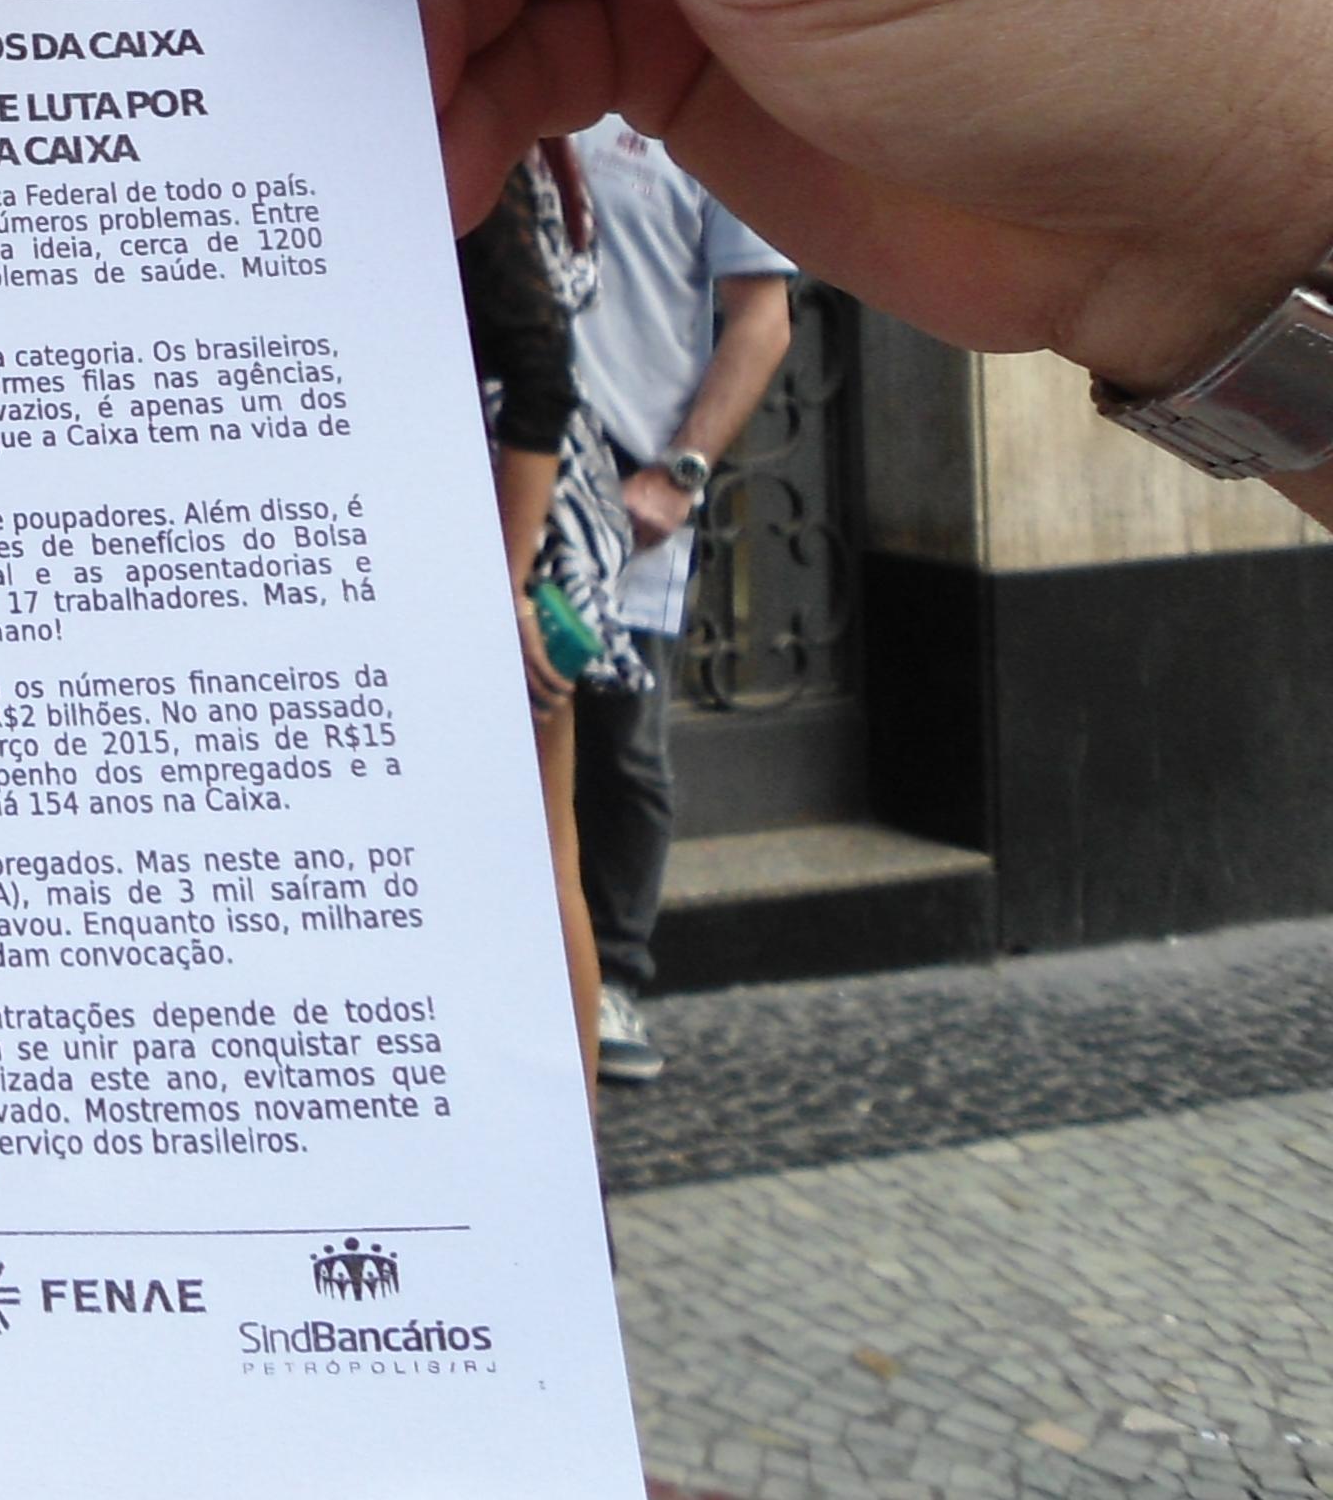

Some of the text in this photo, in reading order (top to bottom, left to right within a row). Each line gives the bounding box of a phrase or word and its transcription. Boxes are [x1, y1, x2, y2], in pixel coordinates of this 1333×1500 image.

[31, 32, 87, 61] DA
[88, 28, 206, 60] CAIXA
[25, 90, 125, 122] LUTA
[126, 87, 211, 119] POR
[23, 132, 142, 167] CAIXA
[25, 180, 118, 207] Federal
[125, 179, 158, 204] de
[163, 177, 223, 202] todo
[231, 181, 247, 199] o
[255, 172, 316, 204] país.
[98, 205, 241, 237] problemas.
[250, 201, 320, 226] Entre
[80, 367, 136, 393] filas
[153, 369, 200, 391] nas
[216, 359, 342, 392] agências,
[35, 566, 52, 586] e
[73, 565, 104, 585] as
[125, 552, 333, 589] aposentadorias
[355, 555, 372, 574] e
[94, 759, 144, 785] dos
[159, 753, 333, 789] empregados
[349, 758, 368, 778] e
[384, 756, 402, 777] a
[28, 790, 80, 817] 154
[88, 794, 154, 816] anos
[162, 792, 197, 814] na
[204, 784, 291, 812] Caixa.
[59, 937, 234, 972] convocação.
[89, 1065, 151, 1092] este
[166, 1069, 228, 1094] ano,
[243, 1061, 376, 1090] evitamos
[391, 1064, 447, 1093] que
[84, 1096, 241, 1124] Mostremos
[253, 1092, 420, 1122] novamente
[433, 1095, 451, 1118] a
[39, 1278, 208, 1314] FENAE
[237, 1318, 493, 1354] SindBancários
